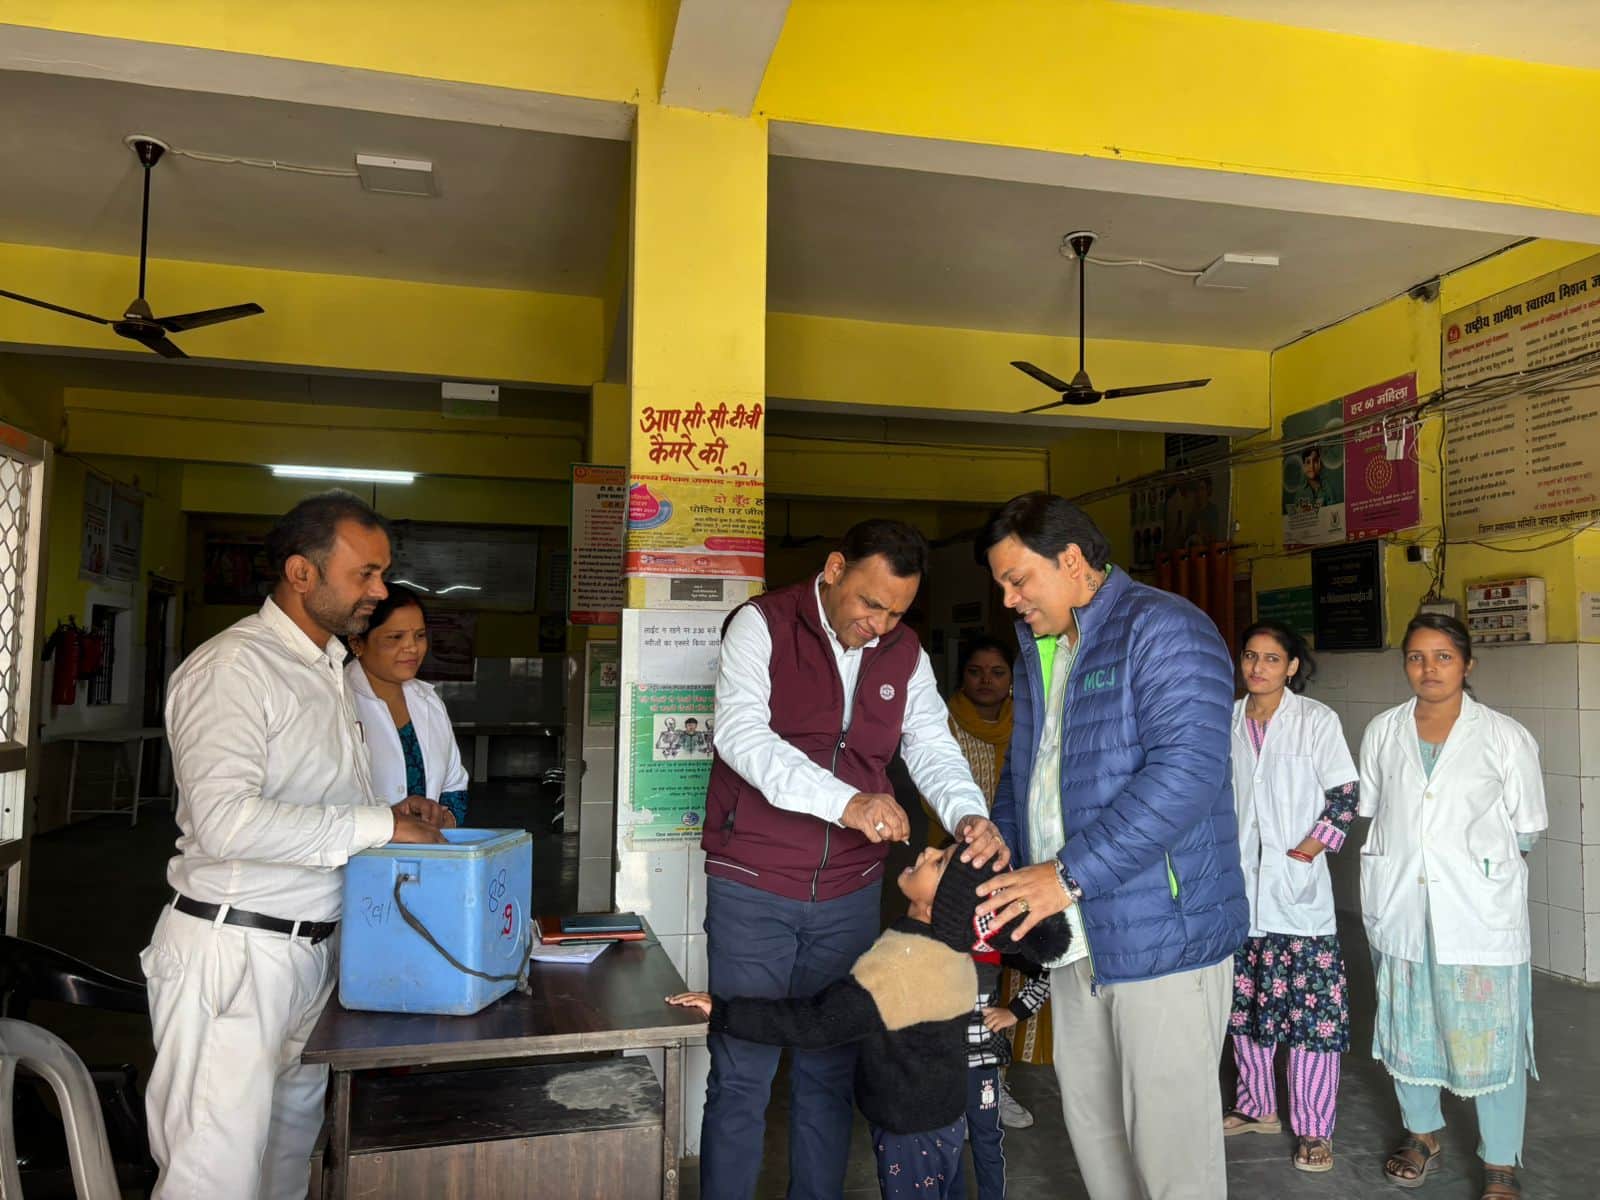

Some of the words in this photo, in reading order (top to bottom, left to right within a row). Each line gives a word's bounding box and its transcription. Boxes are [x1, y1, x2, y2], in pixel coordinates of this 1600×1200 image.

[1464, 315, 1490, 335] राष्ट्रीय
[1493, 304, 1522, 326] ग्रामीण
[1559, 278, 1588, 300] मिशन
[1376, 386, 1409, 405] महिला
[640, 406, 682, 434] आप
[649, 433, 699, 471] कैमरे
[698, 436, 729, 465] की
[689, 503, 725, 515] पोलियो
[728, 508, 742, 516] पर
